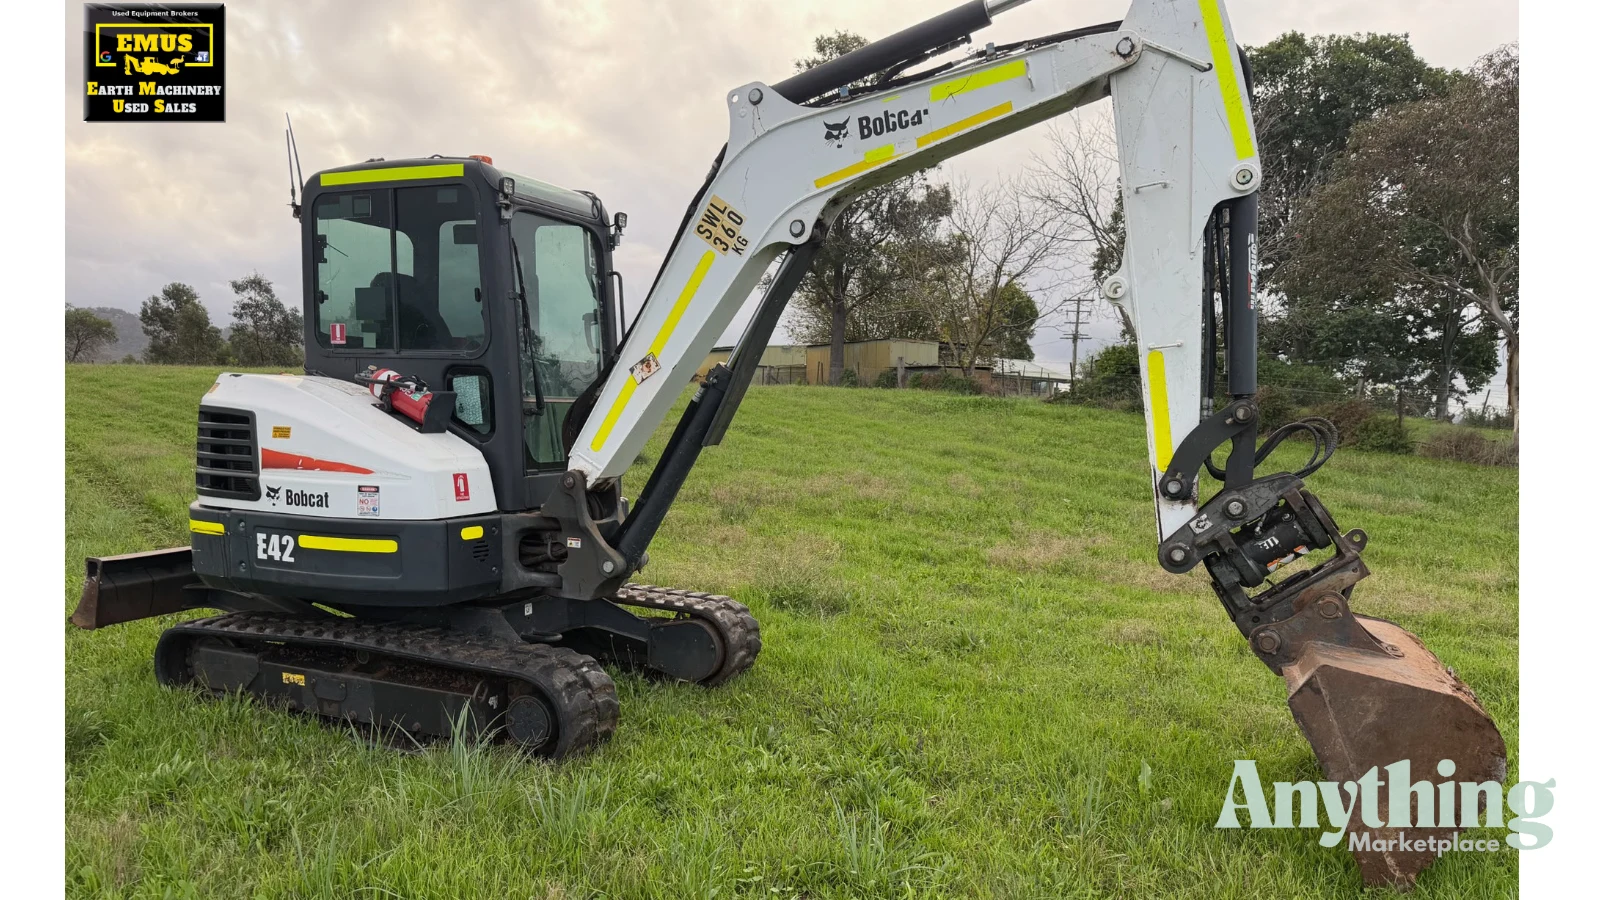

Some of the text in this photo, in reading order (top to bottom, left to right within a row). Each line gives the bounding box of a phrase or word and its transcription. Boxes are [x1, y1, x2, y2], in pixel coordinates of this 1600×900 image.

[858, 109, 929, 140] Bobca
[696, 203, 728, 240] SWL
[713, 210, 744, 252] 360
[731, 235, 749, 256] KG
[285, 489, 330, 508] Bobcat
[256, 532, 295, 563] E42
